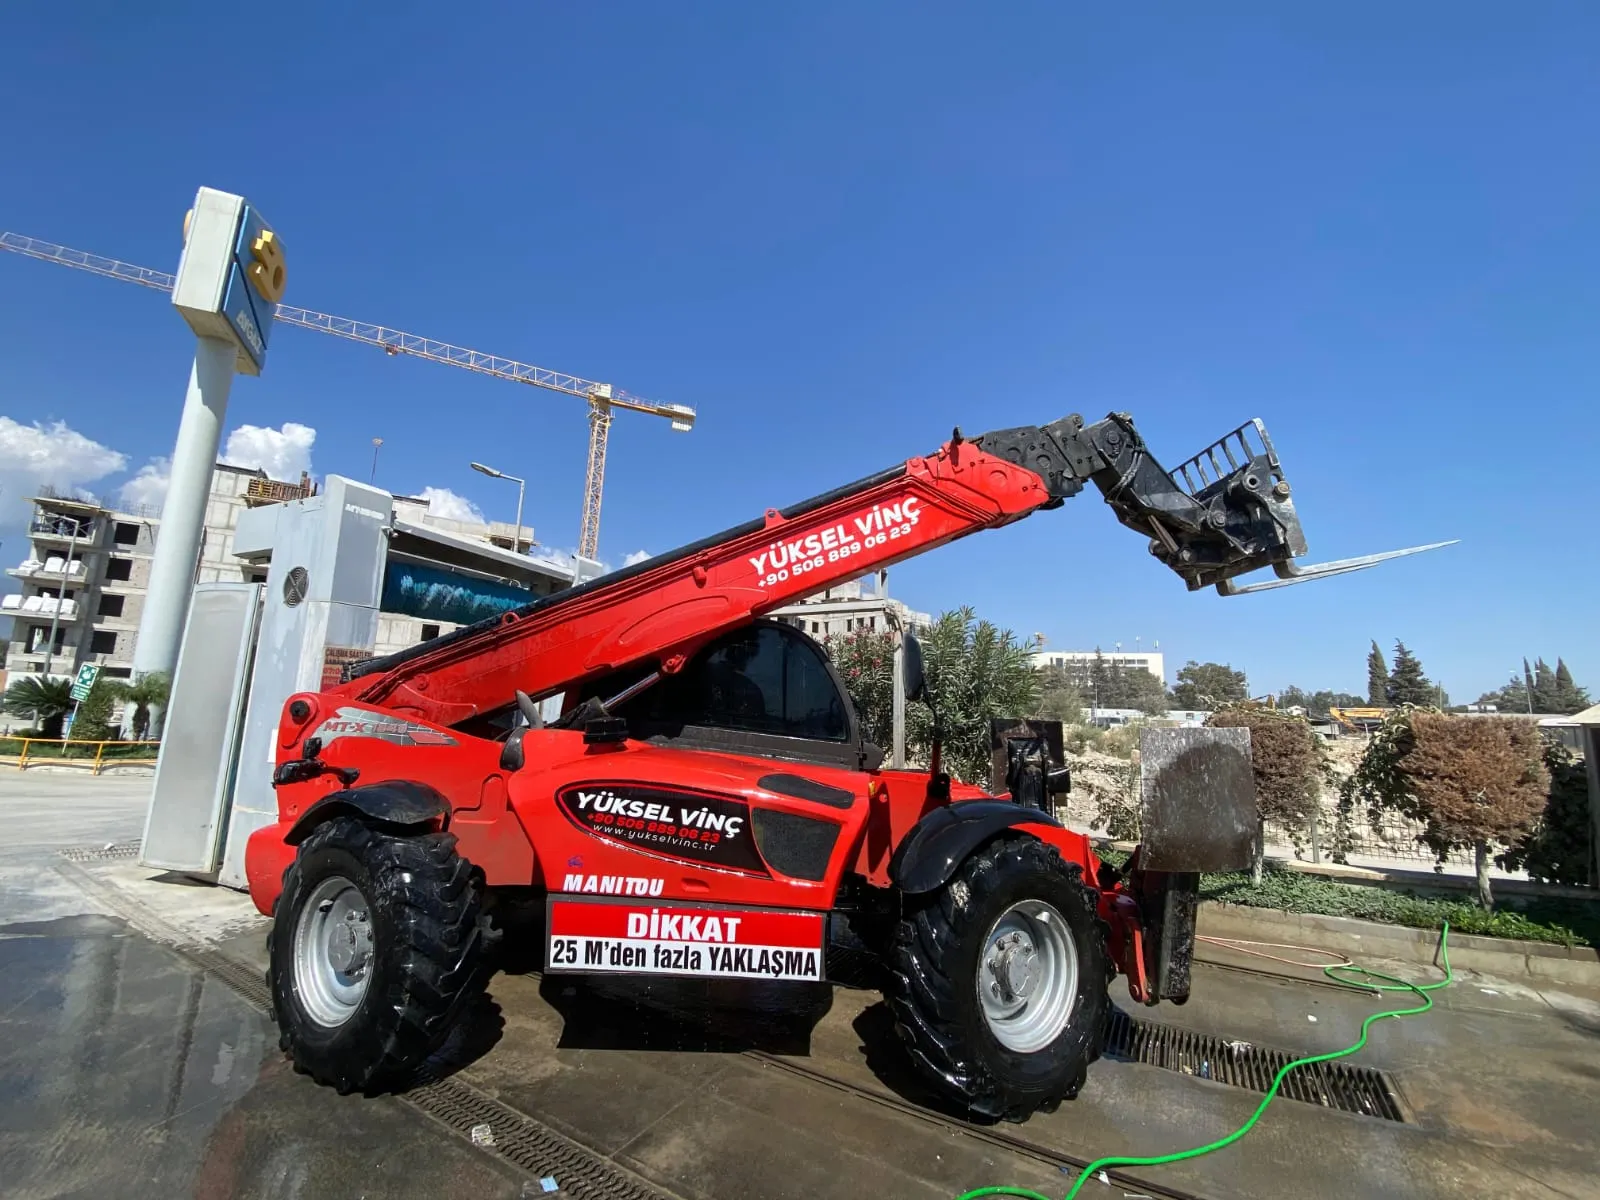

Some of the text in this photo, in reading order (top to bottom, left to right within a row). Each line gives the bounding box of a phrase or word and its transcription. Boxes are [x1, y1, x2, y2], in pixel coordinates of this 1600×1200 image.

[749, 497, 921, 575] YÜKSEL VİNÇ
[758, 522, 912, 588] +90 506 889 06 23
[323, 721, 368, 733] MT-X
[578, 790, 744, 838] YÜKSEL VİNÇ
[587, 812, 720, 843] +90 506 889 06 23
[593, 824, 716, 851] www.yukselvinc.tr
[563, 874, 664, 896] MANITOU
[627, 908, 742, 942] DİKKAT
[552, 939, 578, 964] 25
[653, 944, 702, 970] fazla
[708, 946, 817, 977] YAKLAŞMA
